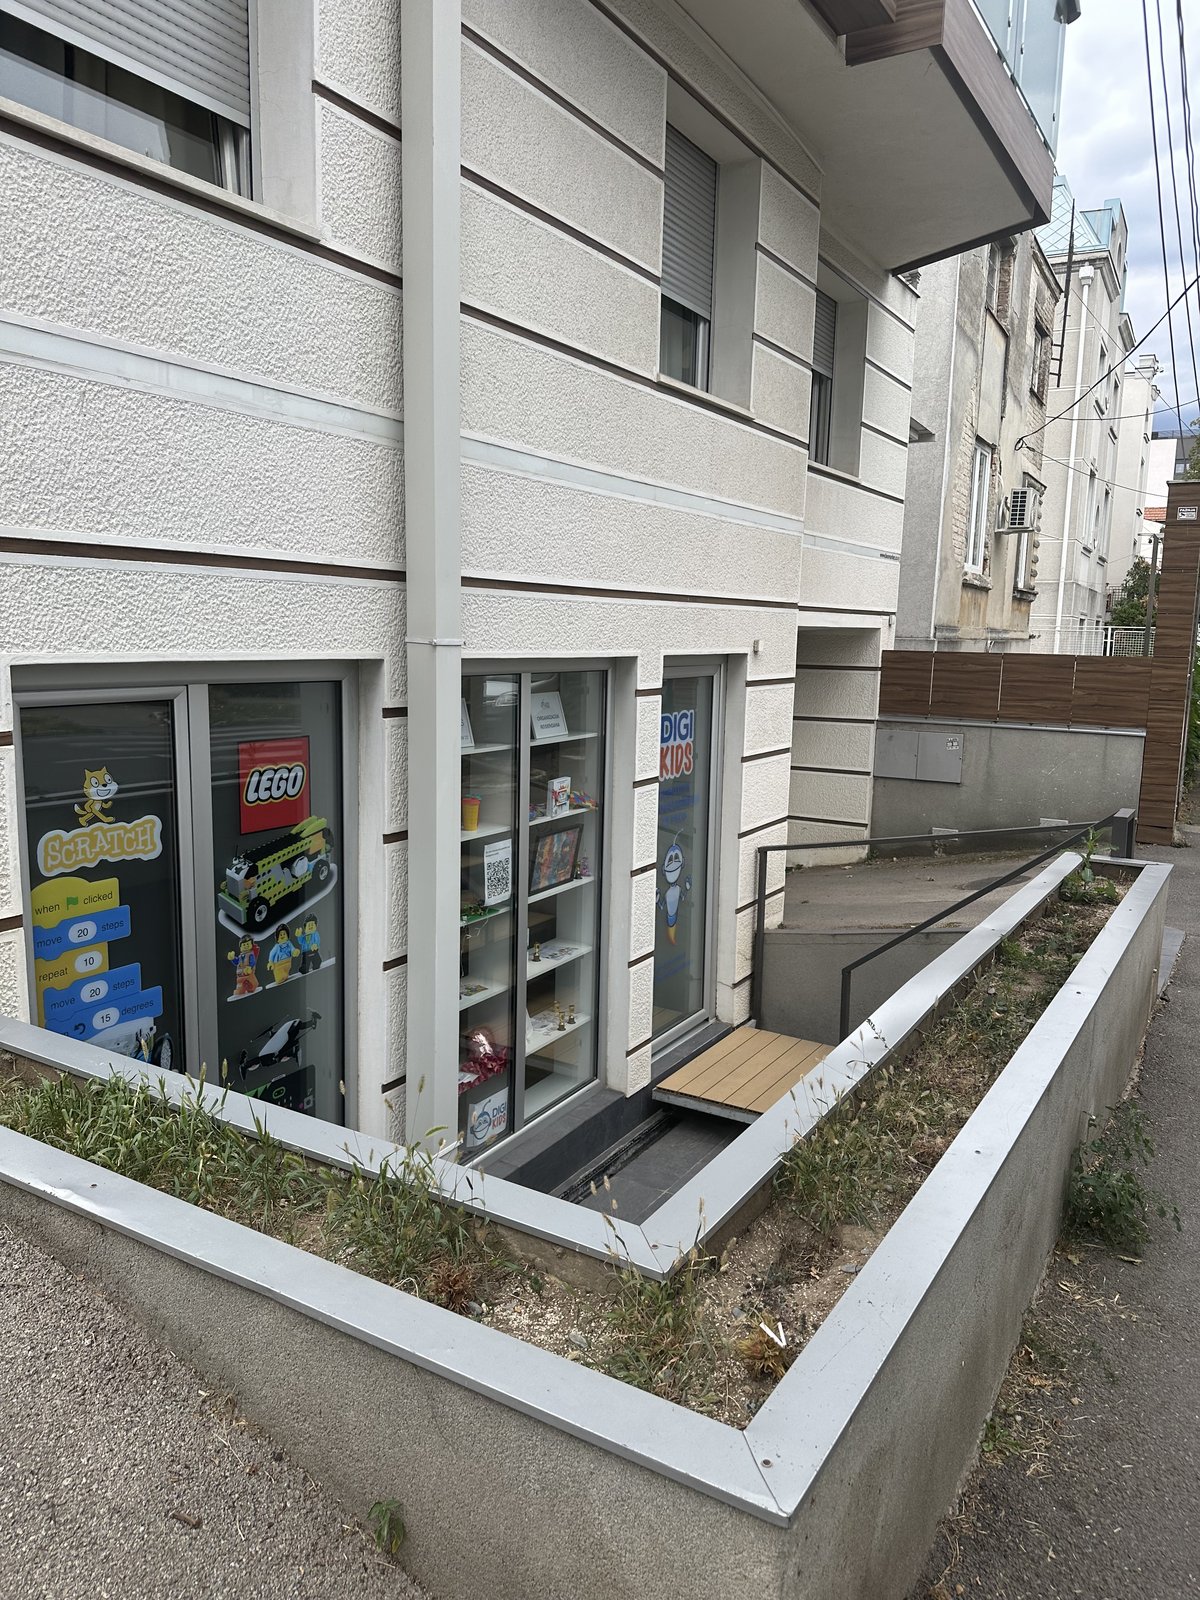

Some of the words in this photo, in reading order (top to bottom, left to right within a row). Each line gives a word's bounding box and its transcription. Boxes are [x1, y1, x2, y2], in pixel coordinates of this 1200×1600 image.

[660, 710, 694, 744] DIGI
[660, 742, 693, 779] KIDS
[245, 764, 305, 803] LEGO
[46, 822, 155, 869] SCRATCH
[35, 903, 60, 915] when
[83, 891, 113, 905] clicked
[36, 937, 63, 949] move
[77, 927, 89, 938] 20
[101, 919, 124, 932] steps
[39, 967, 68, 982] repeat
[84, 956, 95, 967] 10
[50, 997, 76, 1010] move
[89, 987, 101, 998] 20
[112, 978, 135, 991] steps
[101, 1013, 111, 1024] 15
[121, 999, 154, 1017] degrees
[491, 1112, 506, 1130] KIDS
[492, 1101, 507, 1117] DIGI
